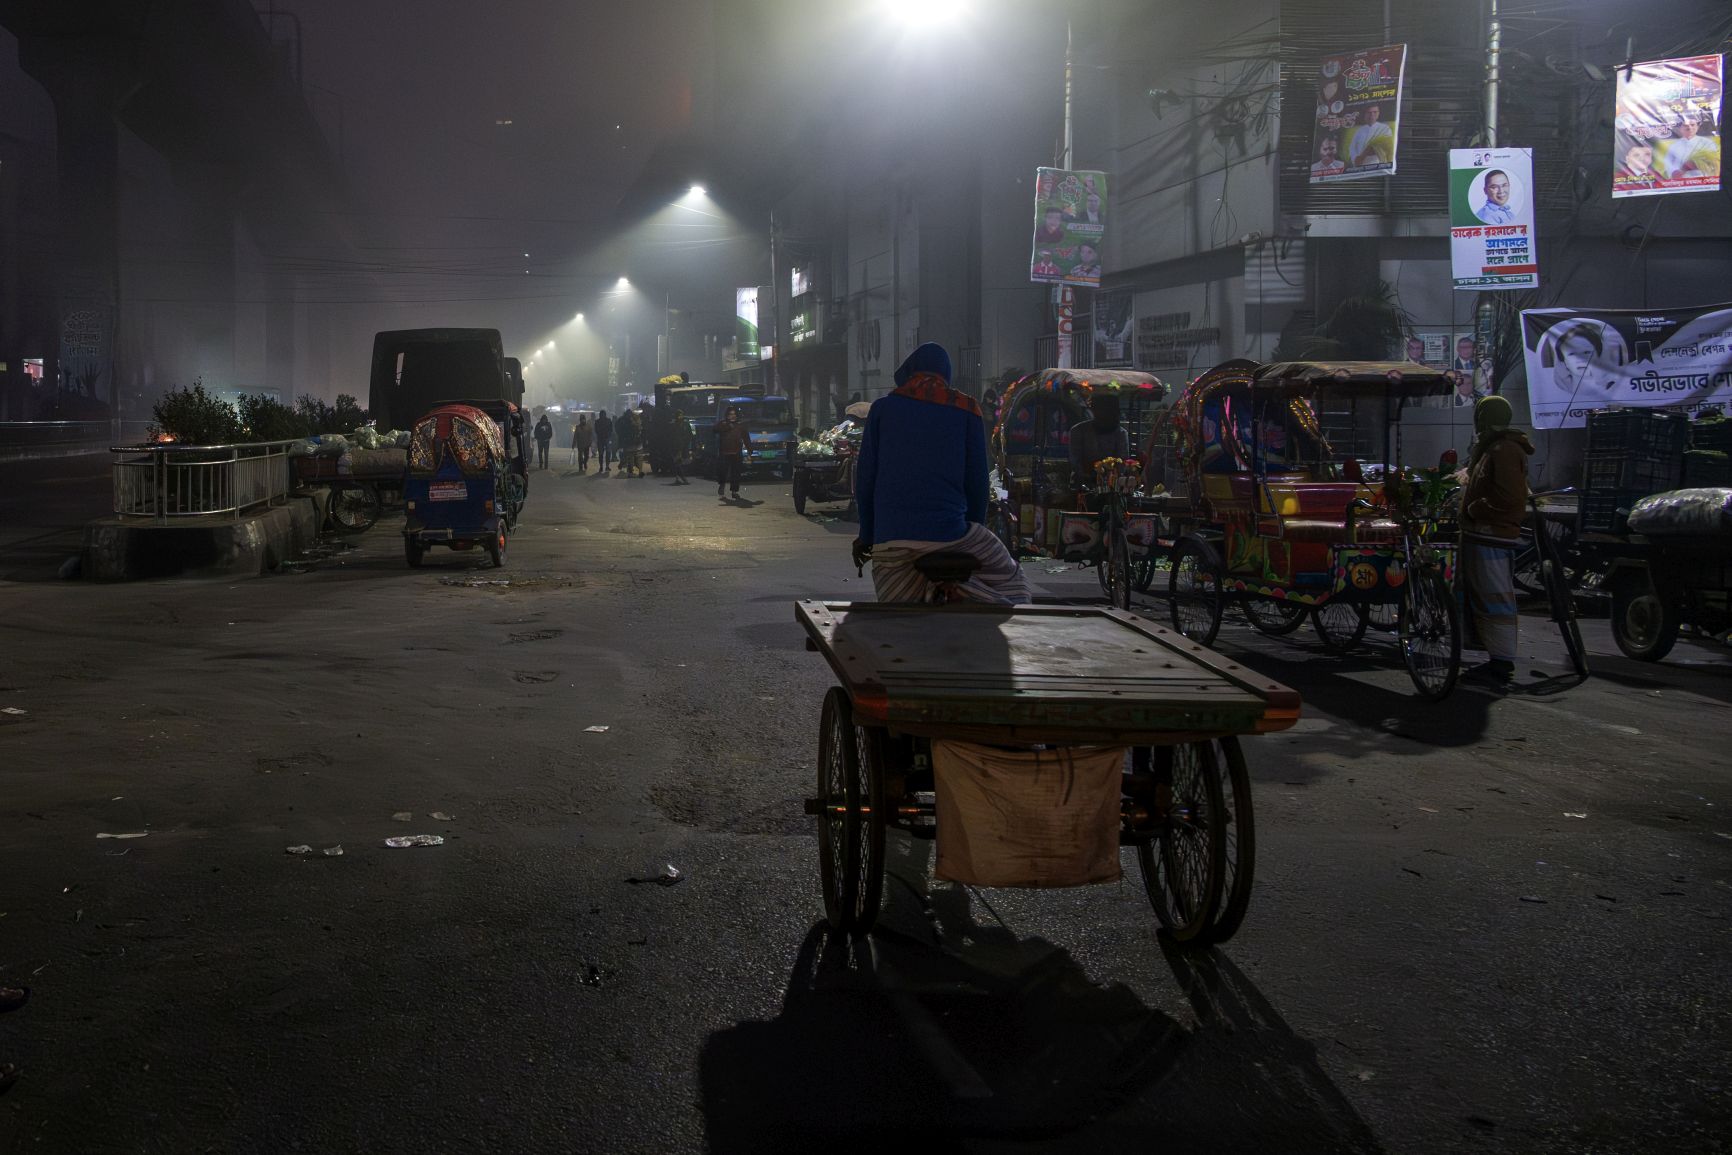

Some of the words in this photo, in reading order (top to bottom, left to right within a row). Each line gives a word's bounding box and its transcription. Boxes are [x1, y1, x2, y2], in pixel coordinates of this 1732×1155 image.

[1451, 228, 1481, 239] তারেক
[1485, 237, 1528, 248] আগমনে
[1486, 256, 1504, 265] মনে
[1457, 277, 1500, 285] ঢাকা-১২
[1661, 342, 1699, 358] দেশনেত্রী
[1702, 344, 1726, 356] বেগম
[1630, 370, 1710, 393] গভীরভাবে
